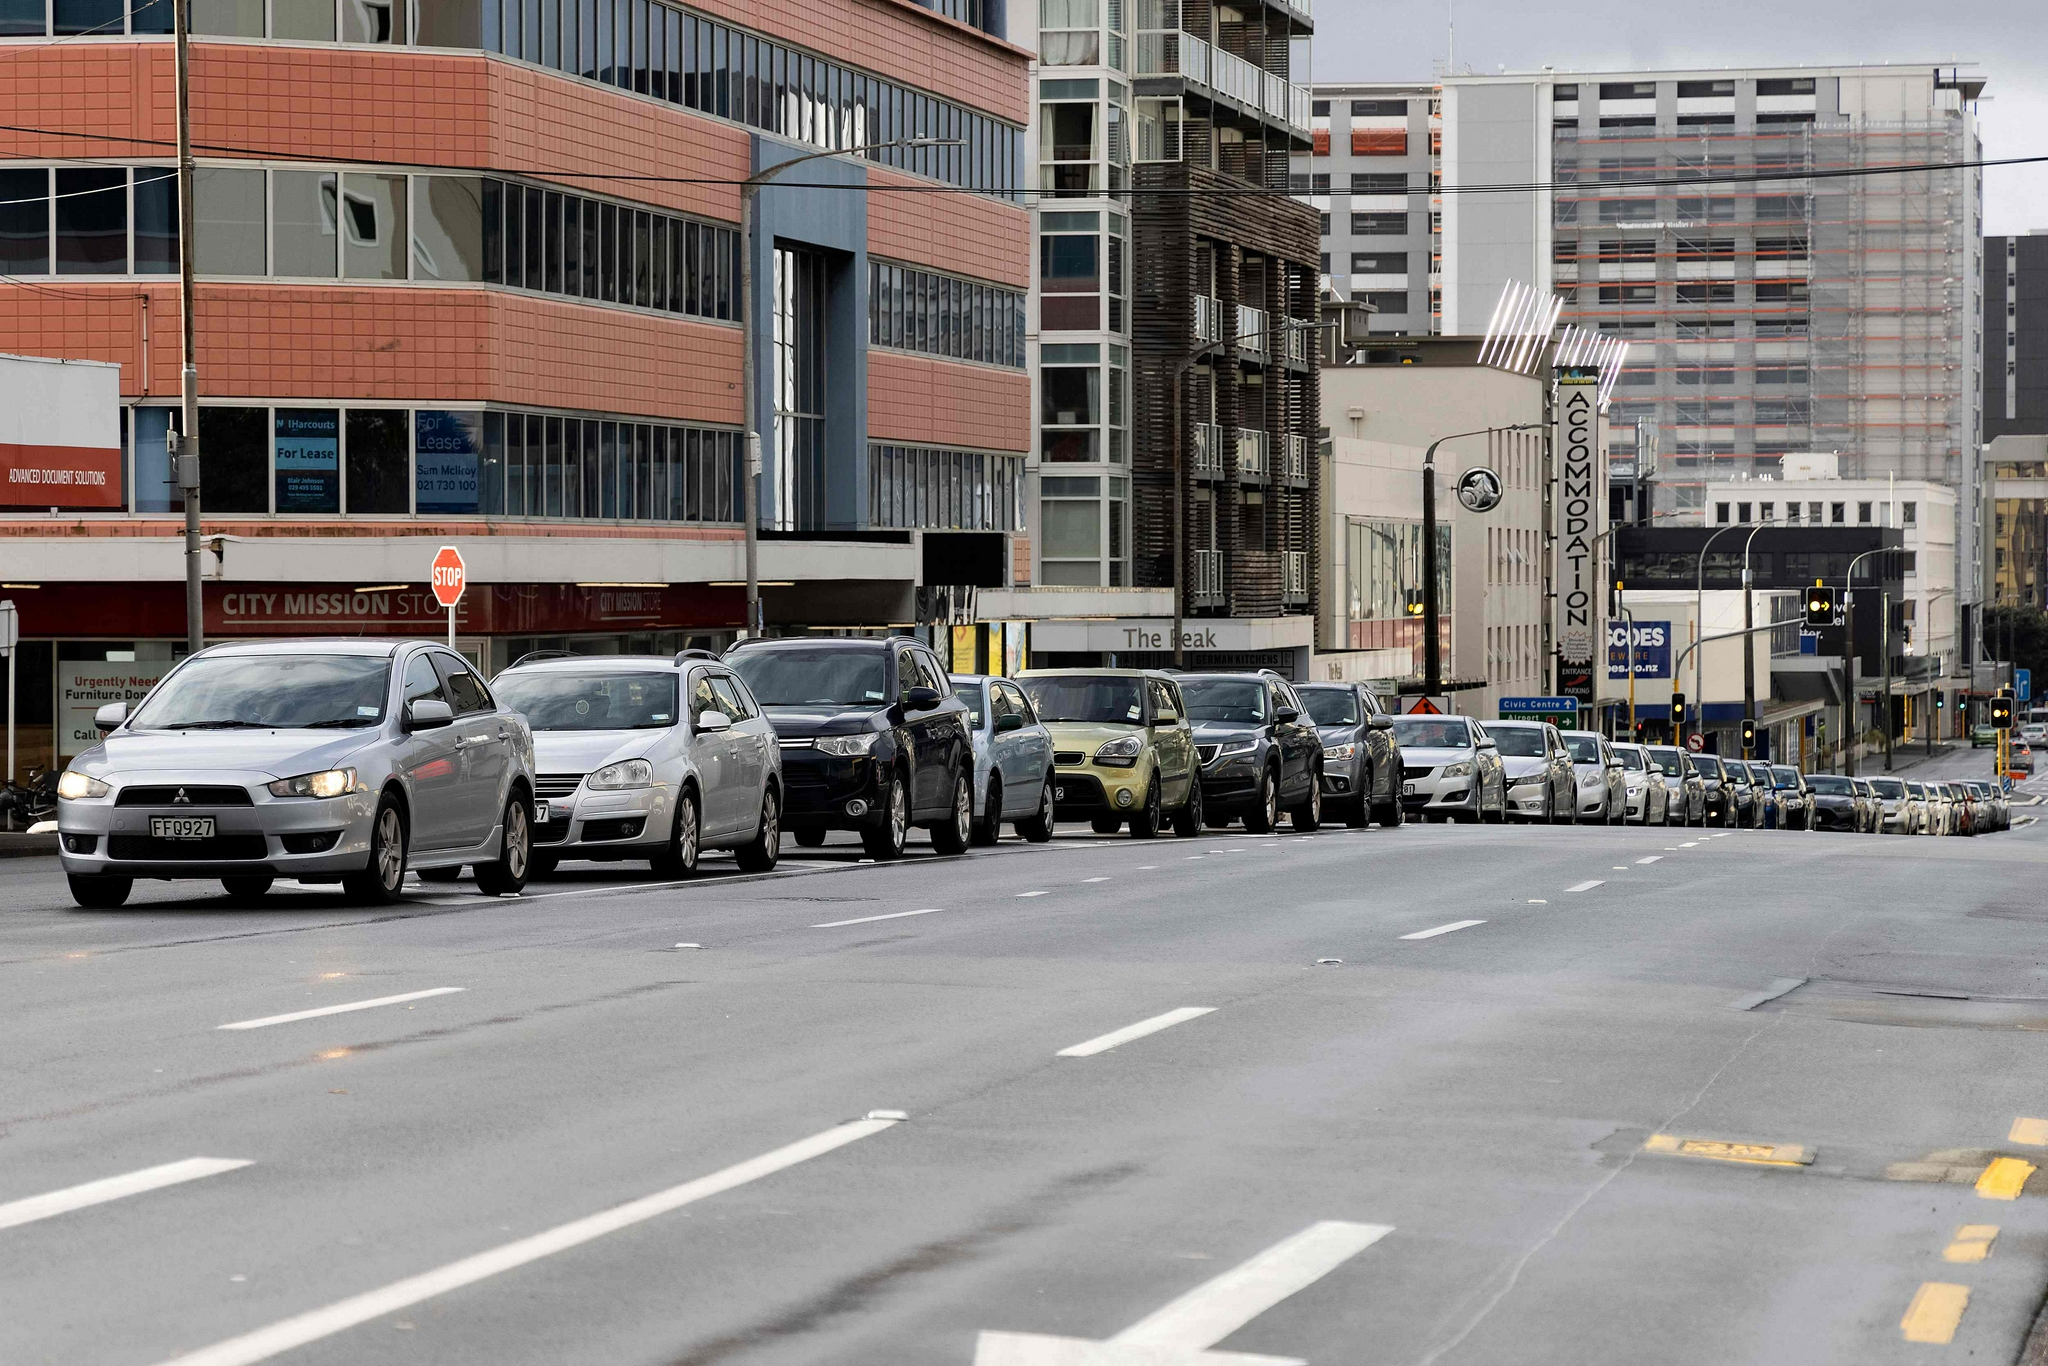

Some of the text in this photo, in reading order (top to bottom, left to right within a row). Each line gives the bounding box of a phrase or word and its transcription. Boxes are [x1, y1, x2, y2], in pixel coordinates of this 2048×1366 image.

[417, 413, 442, 429] For
[417, 432, 462, 450] Lease
[277, 448, 334, 459] For Lease
[416, 464, 438, 475] Sam
[9, 468, 106, 486] ADVANCED DOCUMENT SOLUTIONS
[416, 480, 477, 491] 021 730 100
[1565, 391, 1591, 626] ACCOMMODATION
[434, 566, 462, 587] STOP
[222, 593, 468, 615] CITY MISSION STOE
[600, 592, 615, 612] CITY
[615, 592, 642, 612] MISSION
[1123, 628, 1162, 648] The
[1195, 654, 1234, 665] GERMAN
[1235, 654, 1279, 665] KITCHENS
[1610, 651, 1649, 661] EWRE
[75, 677, 160, 688] Urgently Need
[65, 689, 121, 700] Furniture
[1503, 700, 1560, 708] Civic Centre
[74, 730, 97, 740] Call
[153, 820, 212, 836] FFQ927
